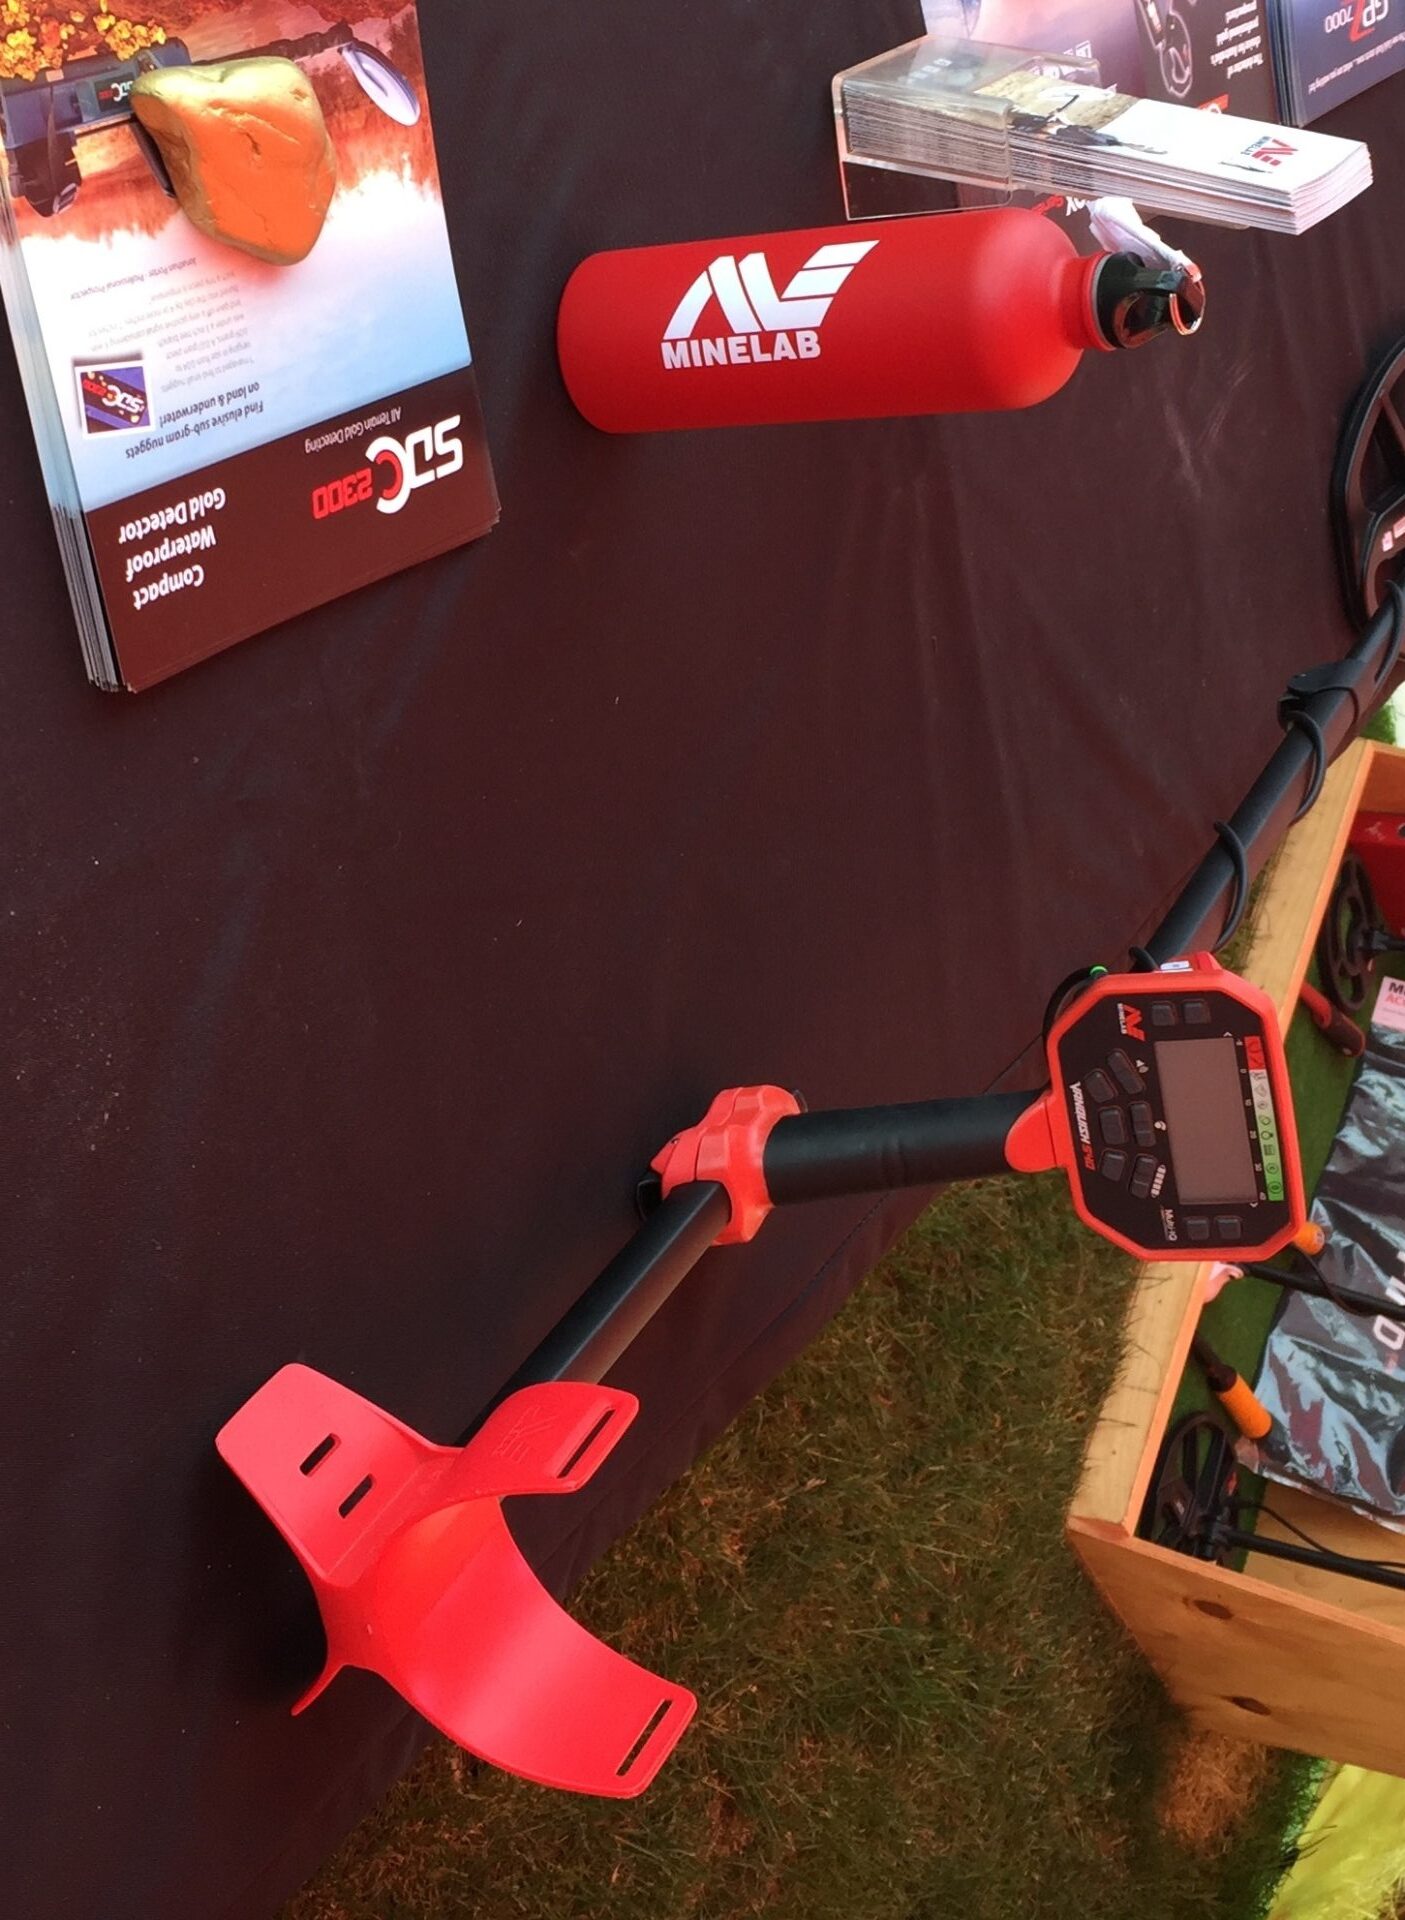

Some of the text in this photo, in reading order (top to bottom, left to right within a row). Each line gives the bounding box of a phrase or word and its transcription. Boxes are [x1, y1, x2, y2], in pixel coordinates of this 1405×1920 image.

[1324, 5, 1353, 33] 7000
[661, 329, 821, 370] MINELAB
[125, 400, 264, 460] Find elusive sub-gram nuggets
[159, 382, 260, 428] on land & underwater!
[305, 406, 401, 454] All Terrain Gold Detecting
[312, 414, 463, 520] SDC 2300
[118, 487, 226, 544] Gold Detector
[125, 525, 216, 583] Waterproof
[132, 564, 204, 611] Compact
[1069, 1080, 1091, 1145] VANQUISH
